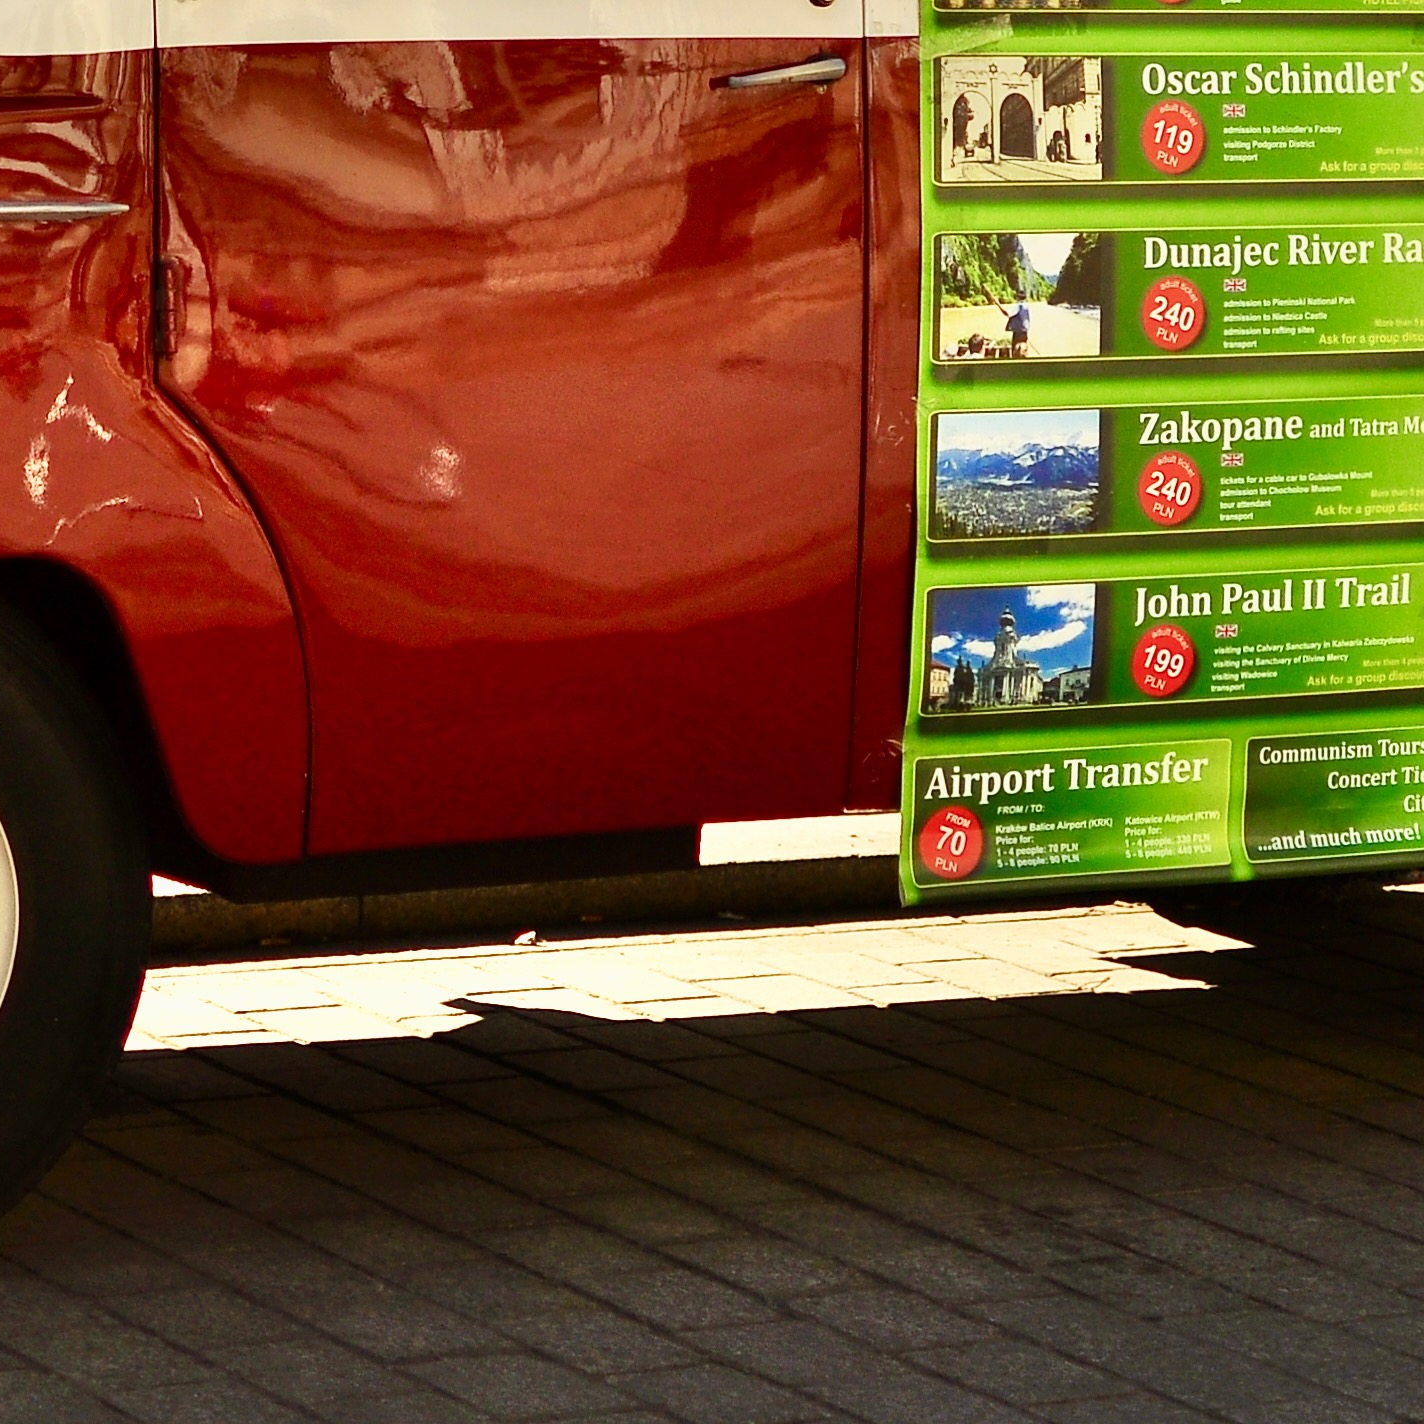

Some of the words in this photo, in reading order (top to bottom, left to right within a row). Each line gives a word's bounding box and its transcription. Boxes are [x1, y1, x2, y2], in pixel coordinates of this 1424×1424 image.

[1142, 63, 1237, 95] Oscar
[1245, 62, 1424, 95] Schindler's
[1153, 120, 1193, 154] 119
[1157, 150, 1179, 167] PLN
[1224, 154, 1258, 162] transport
[1320, 161, 1340, 172] Ask
[1343, 161, 1358, 171] for
[1370, 162, 1400, 173] group
[1144, 236, 1278, 275] Dunajec
[1288, 234, 1374, 265] River
[1339, 297, 1355, 305] Park
[1150, 296, 1194, 331] 240
[1156, 327, 1178, 343] PLN
[1319, 334, 1339, 344] Ask
[1342, 333, 1356, 344] for
[1369, 334, 1398, 346] group
[1139, 412, 1304, 451] Zakopane
[1310, 419, 1344, 438] and
[1350, 417, 1399, 436] Tatra
[1247, 476, 1256, 484] for
[1146, 471, 1191, 506] 240
[1153, 502, 1174, 518] PLN
[1315, 505, 1335, 516] Ask
[1338, 505, 1352, 515] for
[1365, 504, 1395, 516] group
[1135, 585, 1211, 626] John
[1222, 580, 1293, 614] Paul
[1303, 578, 1325, 609] II
[1335, 574, 1410, 608] Trail
[1243, 644, 1254, 652] the
[1144, 645, 1184, 677] 199
[1293, 655, 1301, 663] of
[1144, 675, 1166, 690] PLN
[1211, 683, 1245, 693] transport
[1307, 676, 1326, 686] Ask
[1330, 674, 1343, 685] for
[1356, 674, 1385, 685] group
[1259, 742, 1373, 765] Communism
[925, 763, 1055, 805] Airport
[1064, 752, 1208, 790] Transfer
[1327, 769, 1397, 789] Concert
[997, 806, 1023, 814] FROM
[1031, 804, 1045, 812] TO:
[945, 812, 970, 828] FROM
[1057, 820, 1086, 831] Airport
[1089, 818, 1112, 829] (KRK)
[936, 826, 966, 856] 70
[1258, 830, 1306, 852] ...and
[1310, 827, 1362, 848] much
[1366, 823, 1421, 843] more!
[935, 857, 959, 873] PLN
